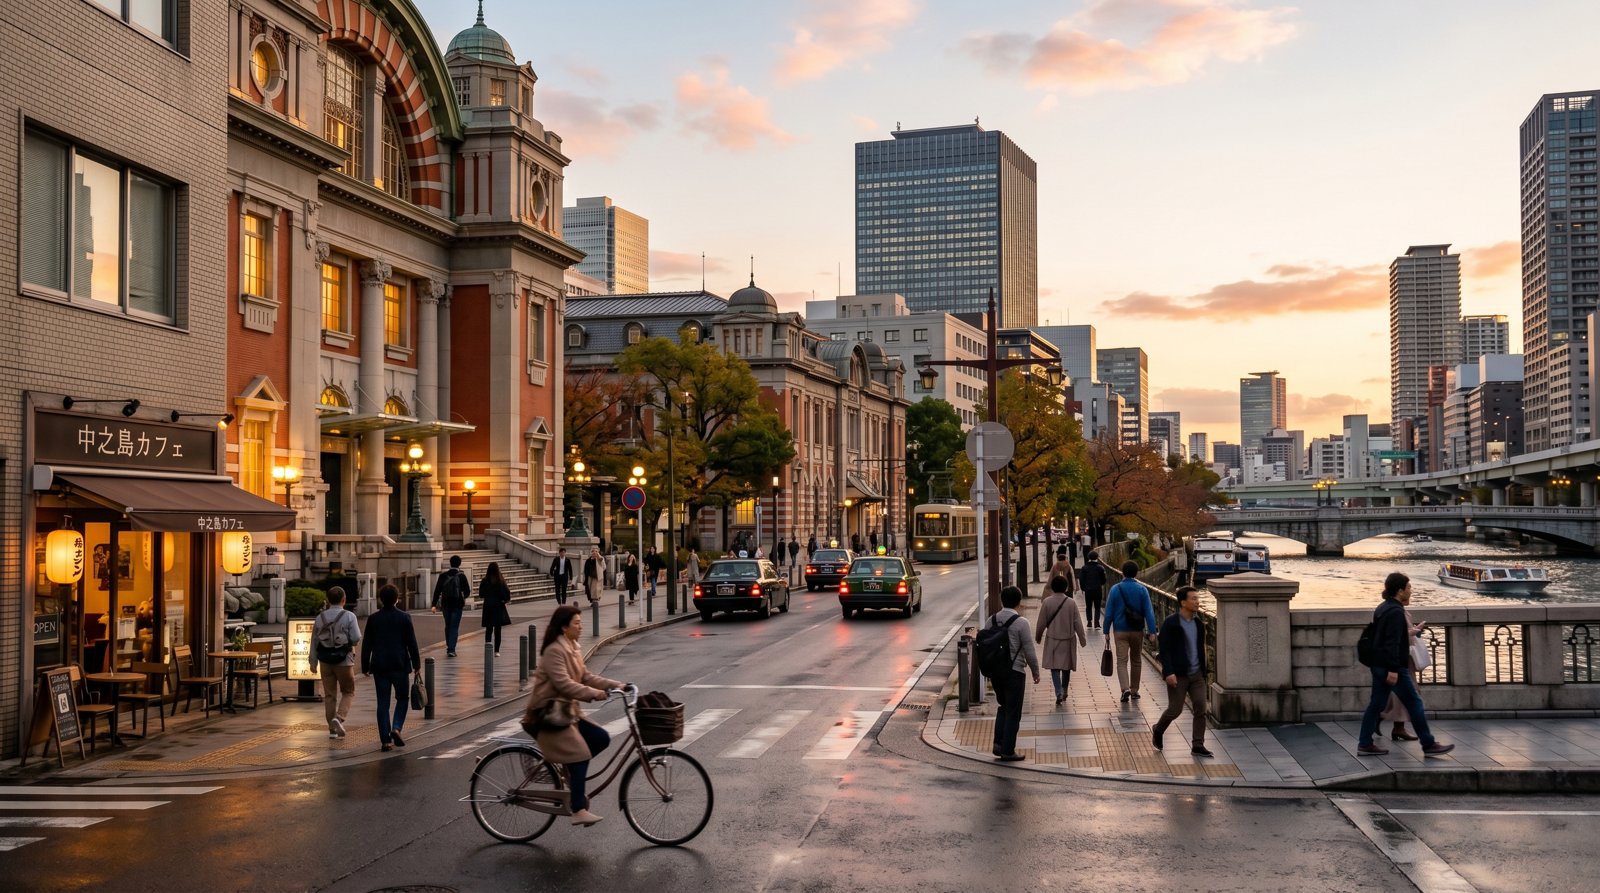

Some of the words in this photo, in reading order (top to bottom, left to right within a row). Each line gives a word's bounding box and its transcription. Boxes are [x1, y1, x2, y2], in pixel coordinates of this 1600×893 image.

[78, 424, 183, 458] 中之島カフェ
[198, 516, 244, 530] 中之島カフェ
[34, 621, 56, 634] OPEN
